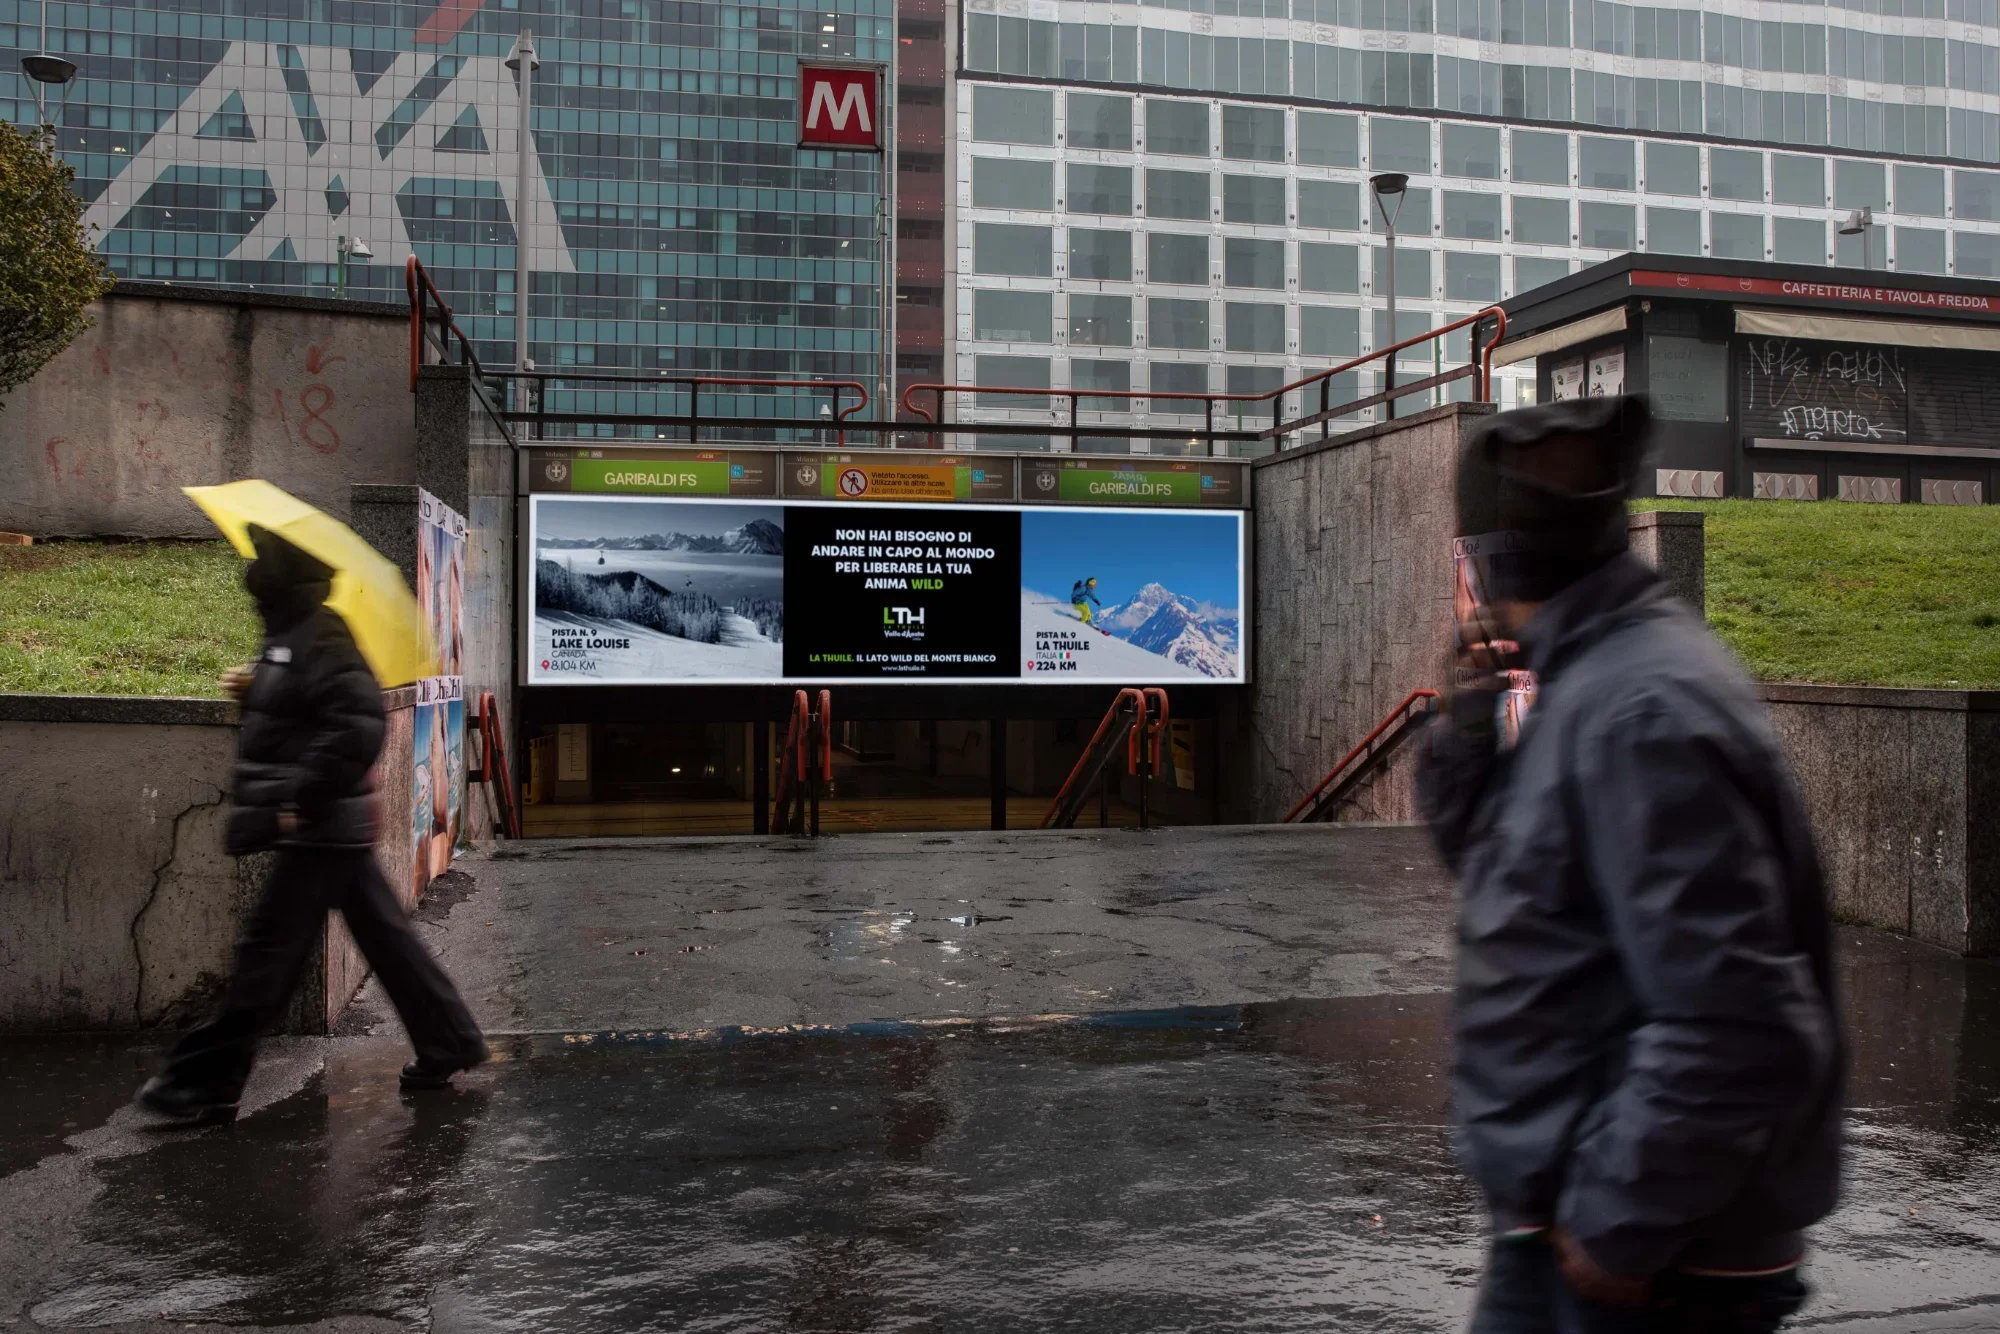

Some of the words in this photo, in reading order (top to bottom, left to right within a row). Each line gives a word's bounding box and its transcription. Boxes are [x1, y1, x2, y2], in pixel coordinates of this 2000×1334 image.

[805, 80, 872, 132] M
[80, 41, 578, 273] AXA
[1782, 281, 1872, 299] CAFFETTERIA
[1874, 289, 1883, 300] E
[1886, 290, 1935, 305] TAVOLA
[1938, 294, 1989, 309] FREDDA
[604, 472, 676, 486] GARIBALDI
[680, 474, 697, 487] FS
[896, 472, 930, 480] l'accesso.
[911, 479, 926, 487] altre
[1089, 482, 1154, 495] GARIBALDI
[1156, 484, 1172, 496] FS
[915, 488, 933, 496] other
[935, 488, 952, 496] stairs
[836, 529, 865, 541] NON
[869, 530, 891, 541] HAI
[895, 531, 955, 542] BISOGNO
[958, 532, 972, 542] DI
[811, 545, 865, 557] ANDARE
[868, 546, 882, 557] IN
[885, 547, 923, 558] CAPO
[926, 548, 942, 558] AL
[945, 548, 995, 559] MONDO
[1454, 539, 1480, 557] Chloé
[835, 562, 860, 573] PER
[863, 562, 923, 574] LIBERARE
[927, 563, 942, 574] LA
[946, 563, 972, 574] TUA
[864, 578, 907, 589] ANIMA
[911, 579, 944, 590] WILD
[884, 607, 925, 624] LTH
[1036, 631, 1059, 639] PISTA
[552, 638, 583, 649] LAKE
[587, 638, 630, 649] LOUISE
[1036, 641, 1050, 650] LA
[1053, 641, 1090, 650] THUILE
[551, 650, 587, 658] CANADA
[810, 654, 820, 662] LA
[822, 654, 854, 662] THUILE.
[551, 660, 577, 671] 8.104
[580, 660, 596, 671] KM
[1036, 661, 1056, 671] 224
[1060, 662, 1077, 671] KM
